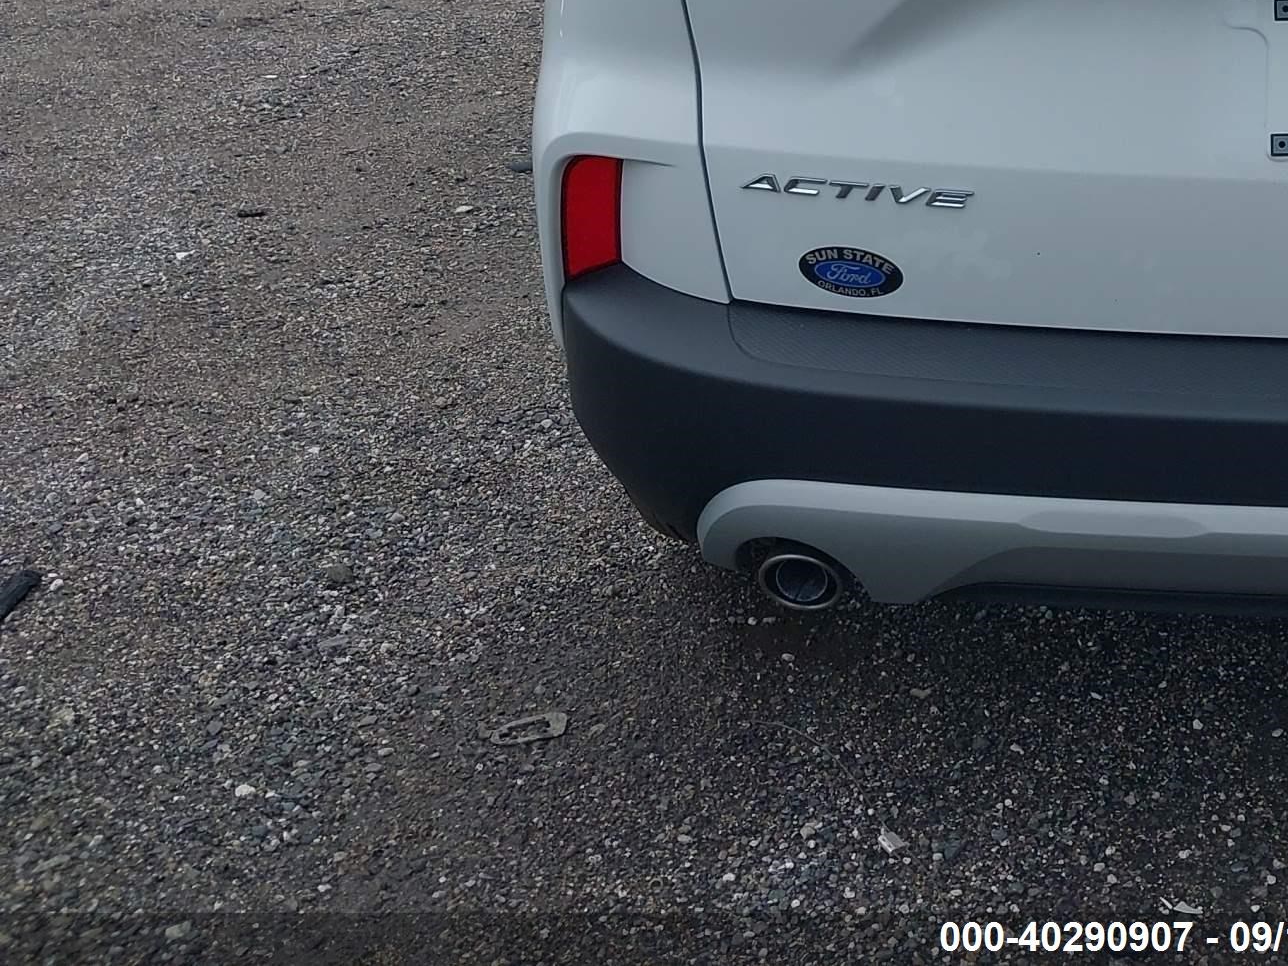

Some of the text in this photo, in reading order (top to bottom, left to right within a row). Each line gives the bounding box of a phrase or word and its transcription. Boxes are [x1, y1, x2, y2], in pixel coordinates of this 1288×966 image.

[740, 173, 975, 209] ACTIVE
[805, 249, 894, 275] SUN STATE
[826, 263, 872, 284] Ford
[871, 287, 884, 296] FL
